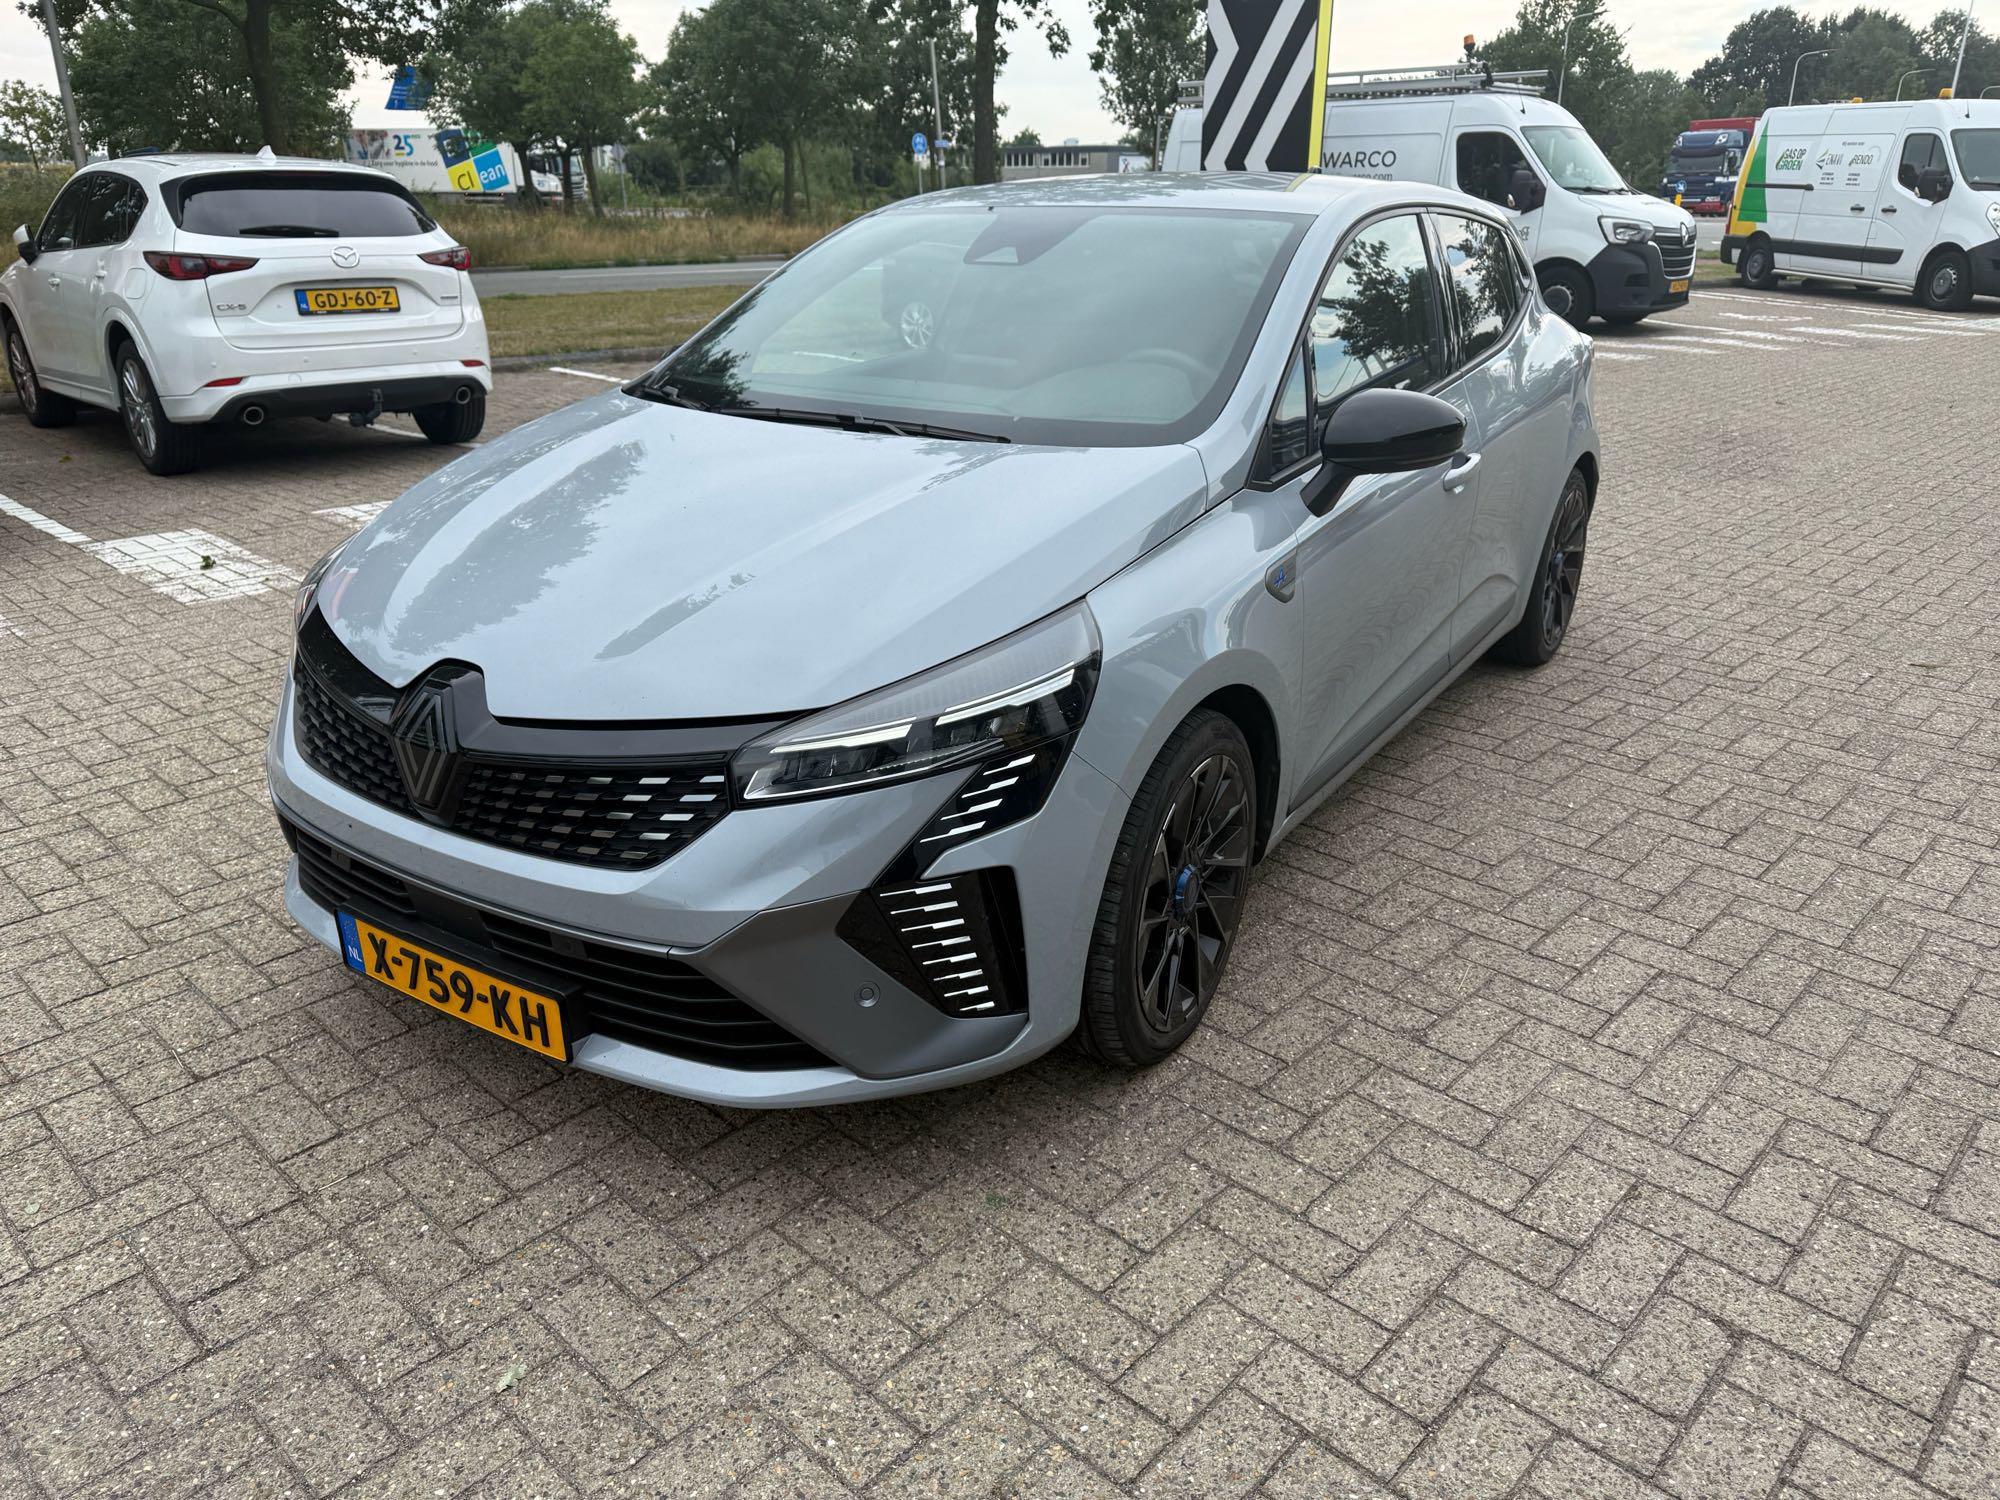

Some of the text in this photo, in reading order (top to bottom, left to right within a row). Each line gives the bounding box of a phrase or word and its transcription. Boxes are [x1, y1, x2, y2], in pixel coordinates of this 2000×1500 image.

[392, 134, 414, 156] 25
[1784, 148, 1798, 160] GAS
[1323, 150, 1396, 168] WARCO
[314, 290, 393, 308] GDJ-60-Z
[348, 948, 362, 962] NL
[368, 932, 550, 1048] X-759-KH
